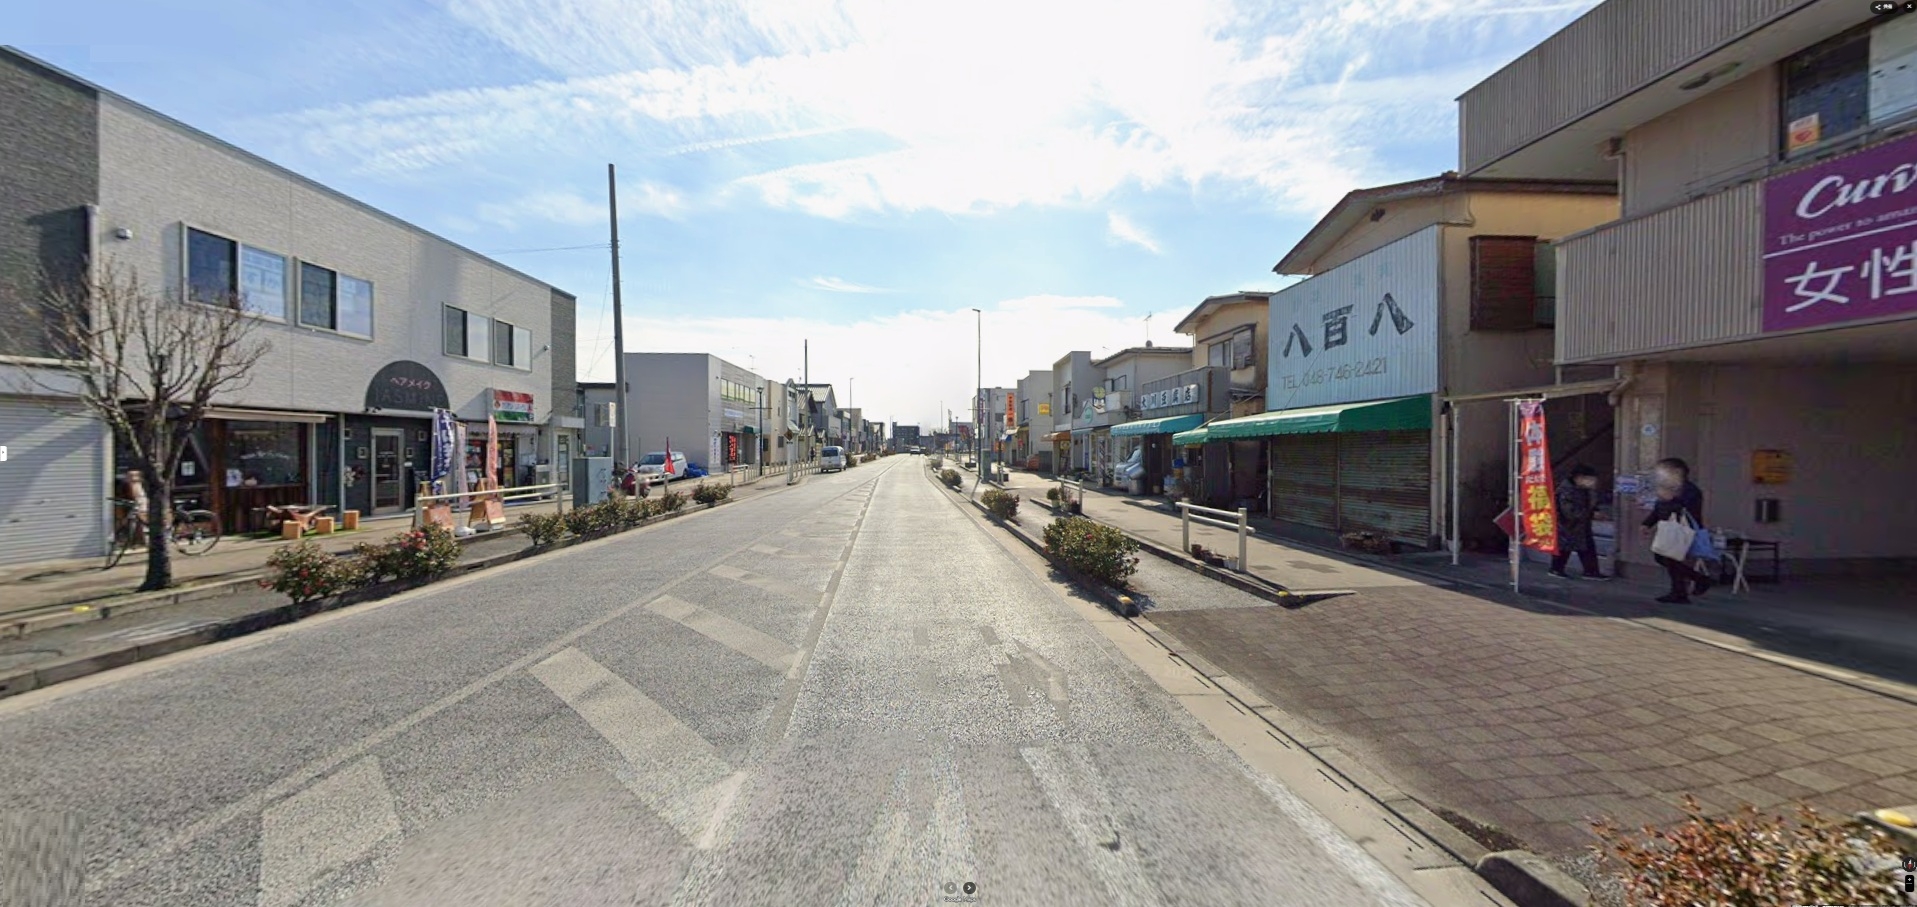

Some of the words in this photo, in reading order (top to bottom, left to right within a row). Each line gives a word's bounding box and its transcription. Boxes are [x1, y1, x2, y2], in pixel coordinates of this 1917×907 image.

[1779, 233, 1806, 246] The
[1808, 222, 1854, 242] power
[1784, 239, 1917, 313] 女性
[1283, 292, 1415, 358] 八百八
[390, 376, 432, 390] ヘアメイク
